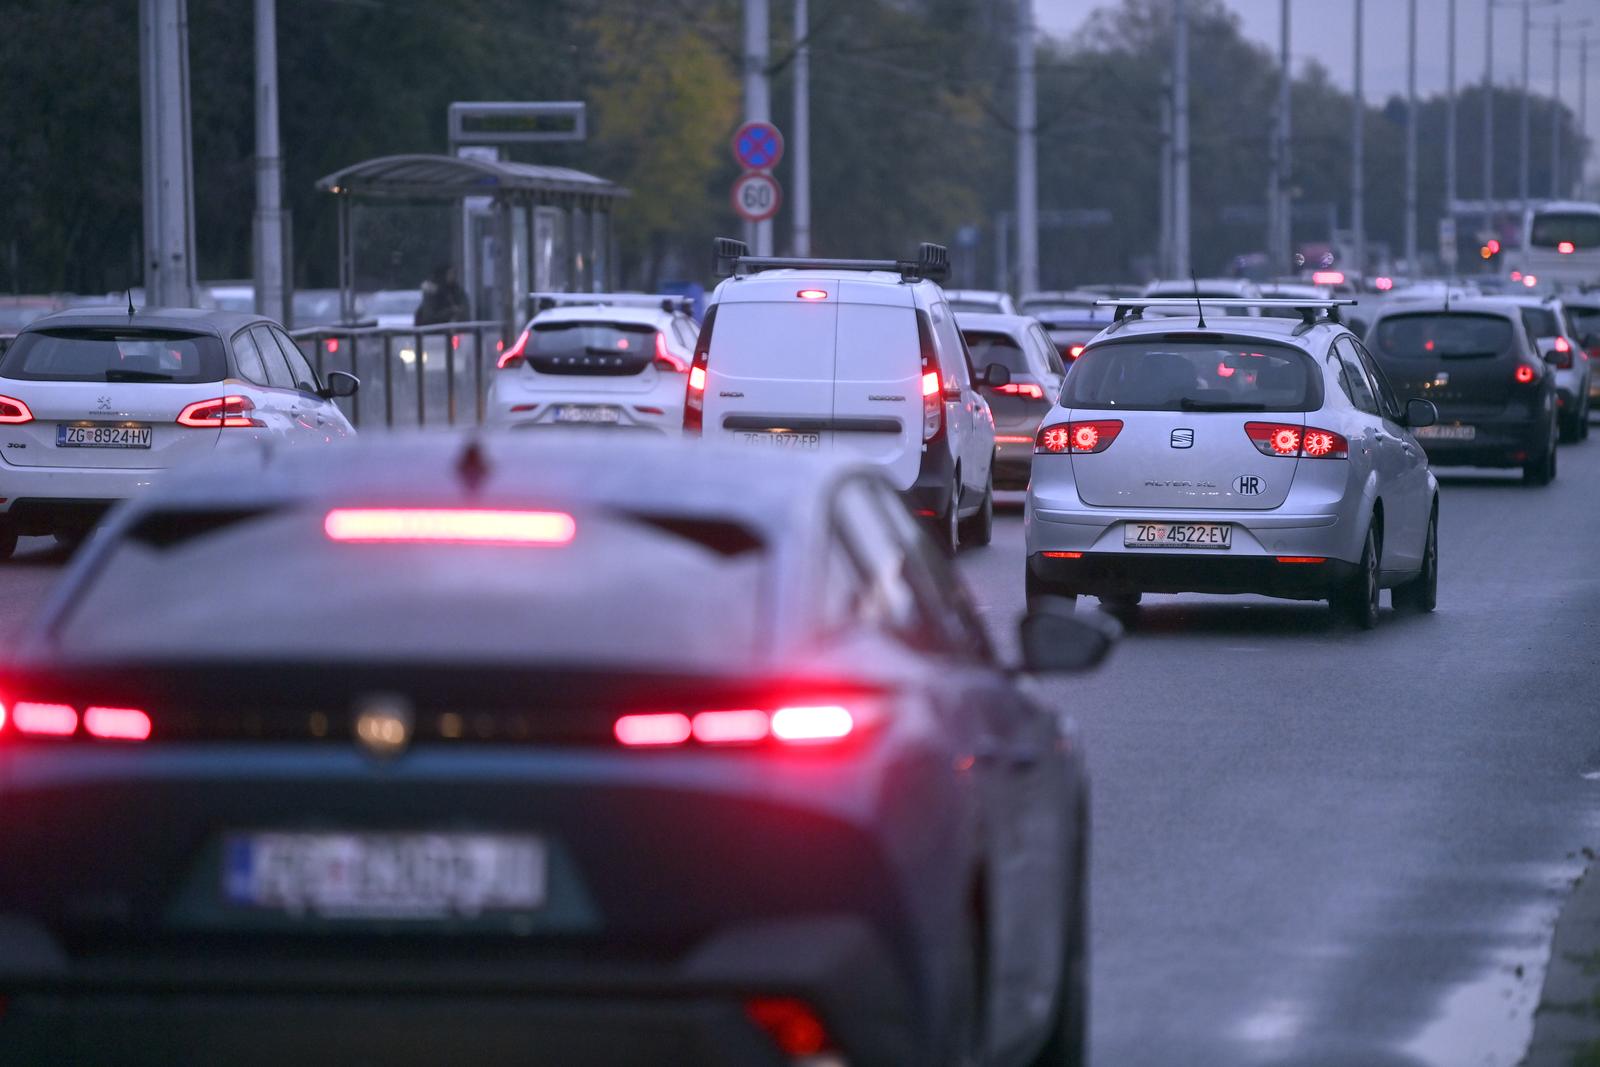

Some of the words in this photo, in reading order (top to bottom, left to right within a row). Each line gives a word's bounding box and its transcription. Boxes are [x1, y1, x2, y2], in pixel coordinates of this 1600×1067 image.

[744, 184, 770, 207] 60
[68, 427, 85, 442] ZG
[1240, 476, 1259, 495] HR
[1137, 525, 1156, 541] ZG
